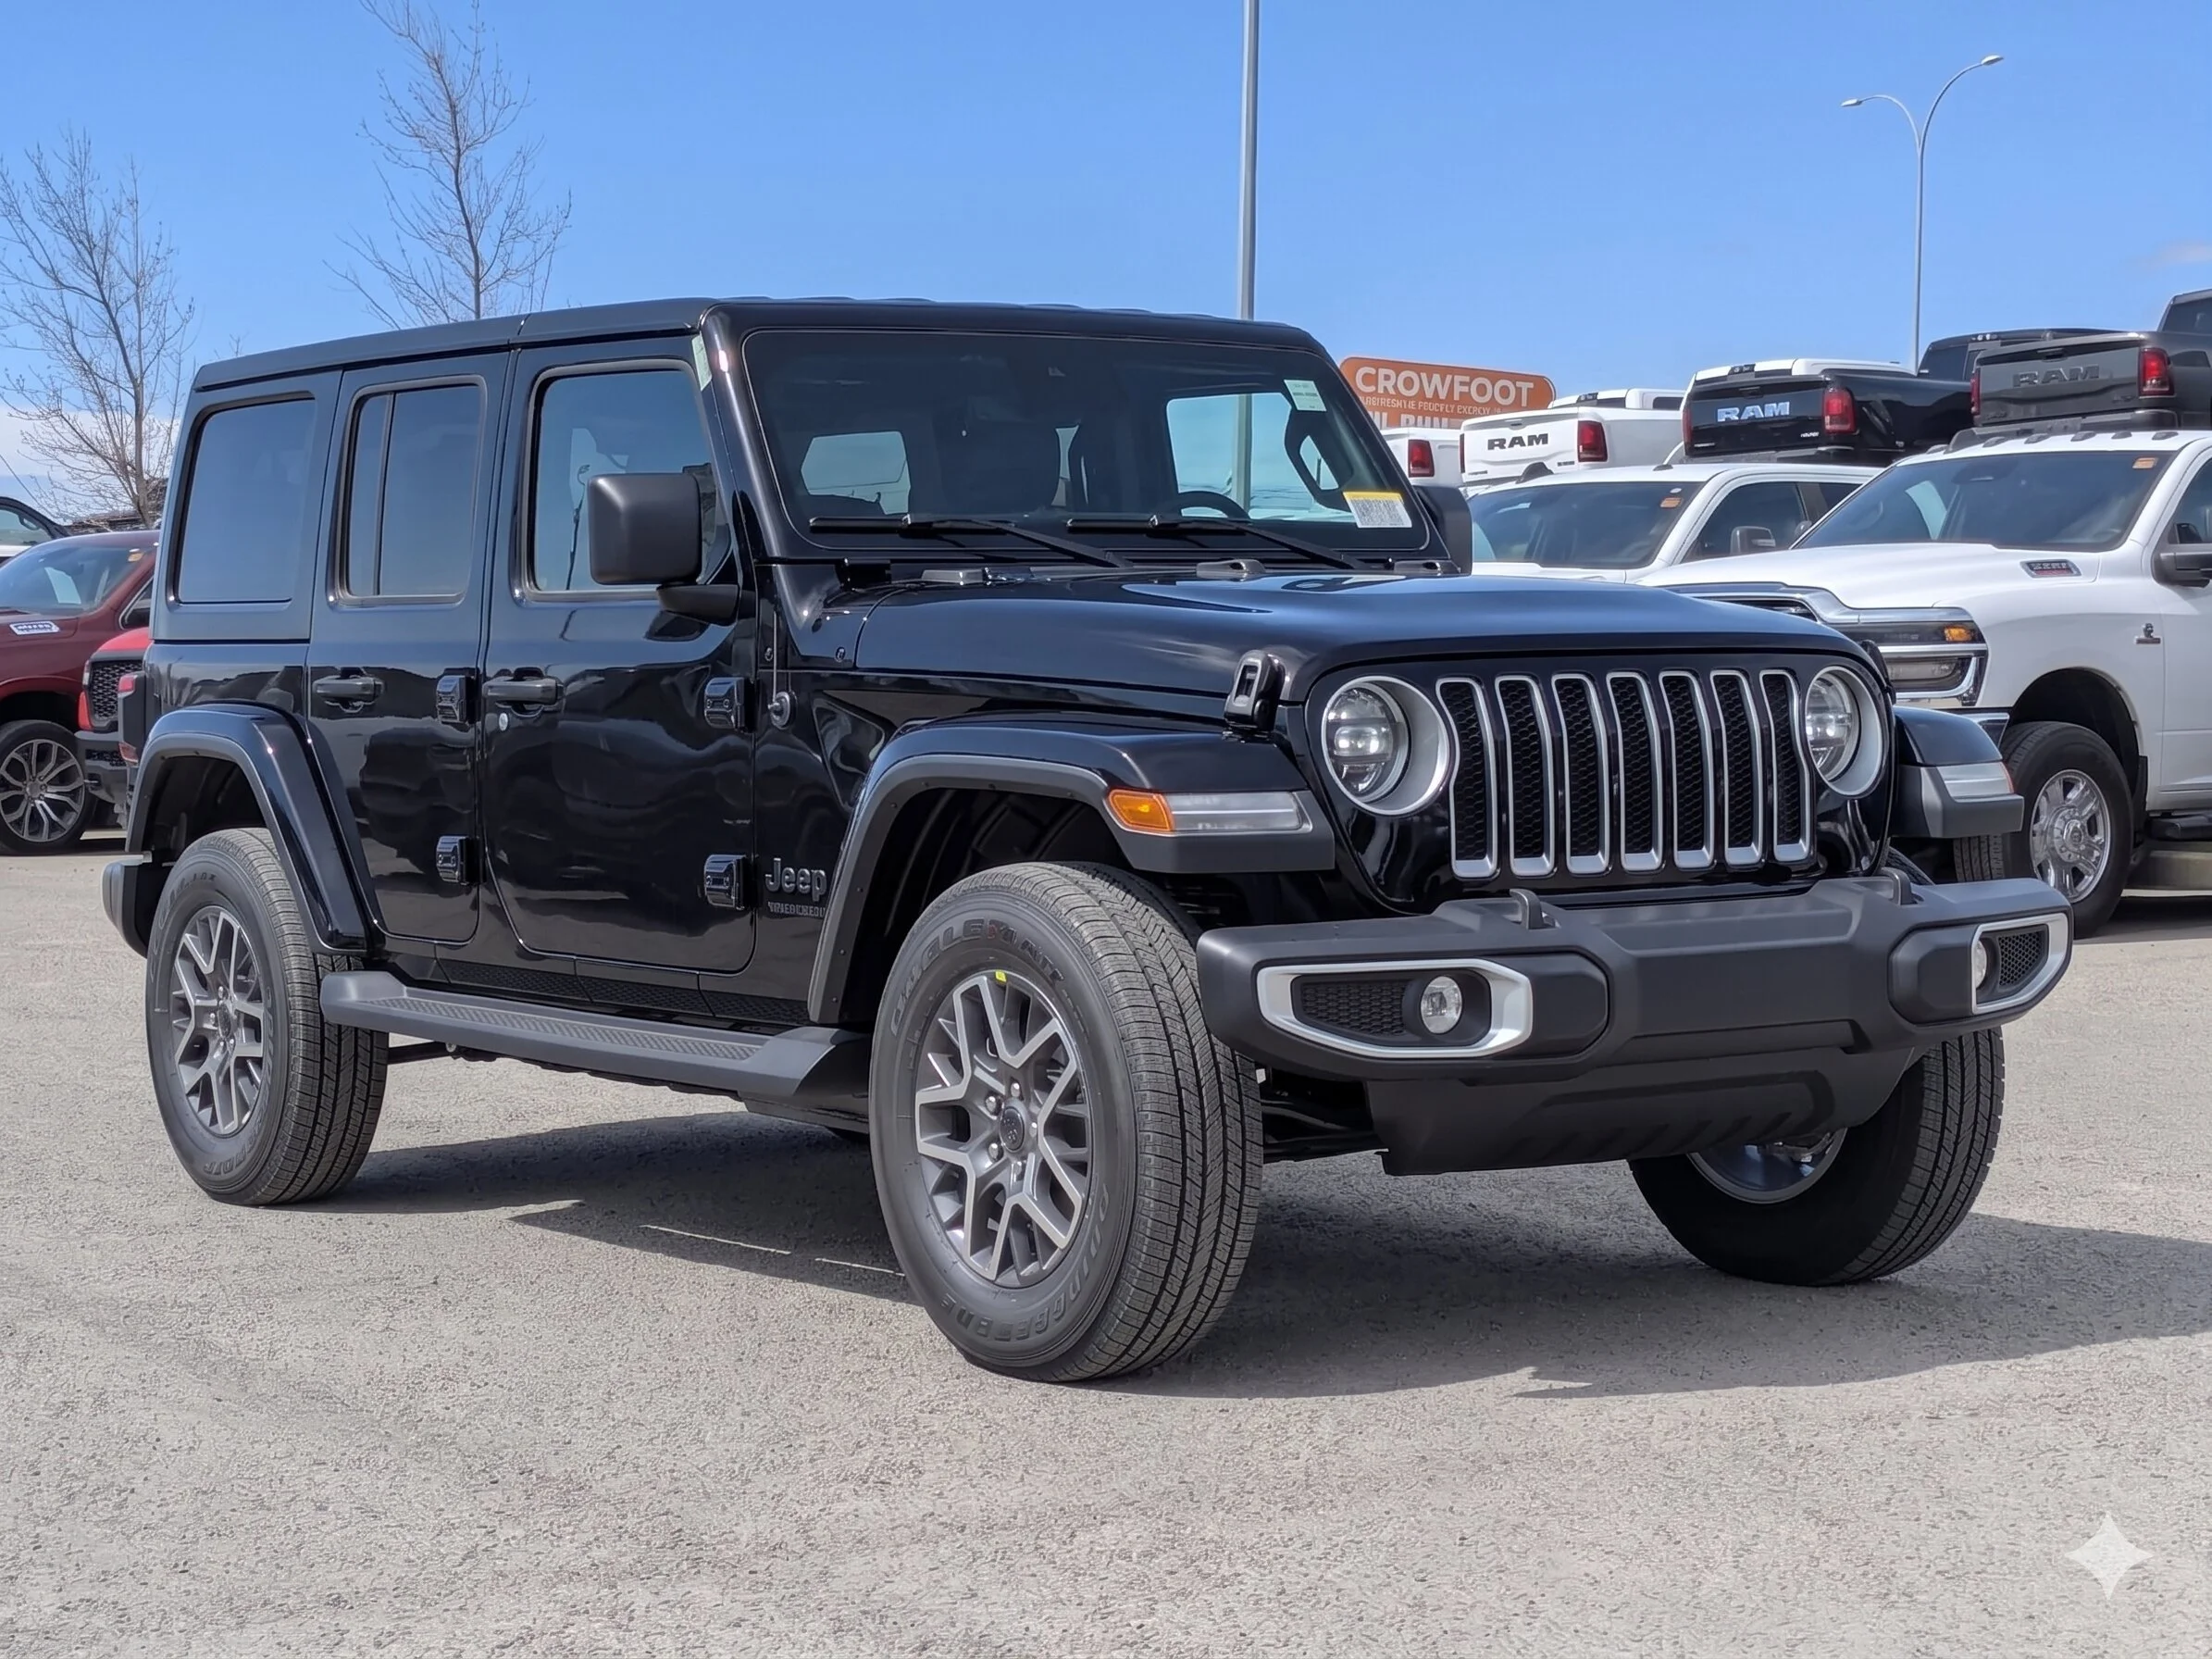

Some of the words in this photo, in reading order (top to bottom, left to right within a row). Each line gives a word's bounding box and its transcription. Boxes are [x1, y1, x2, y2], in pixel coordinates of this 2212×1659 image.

[1355, 367, 1535, 407] CROWFOOT
[2012, 365, 2100, 388] RAM
[1716, 401, 1791, 422] RAM
[1487, 433, 1548, 451] RAM
[764, 857, 827, 902] Jeep
